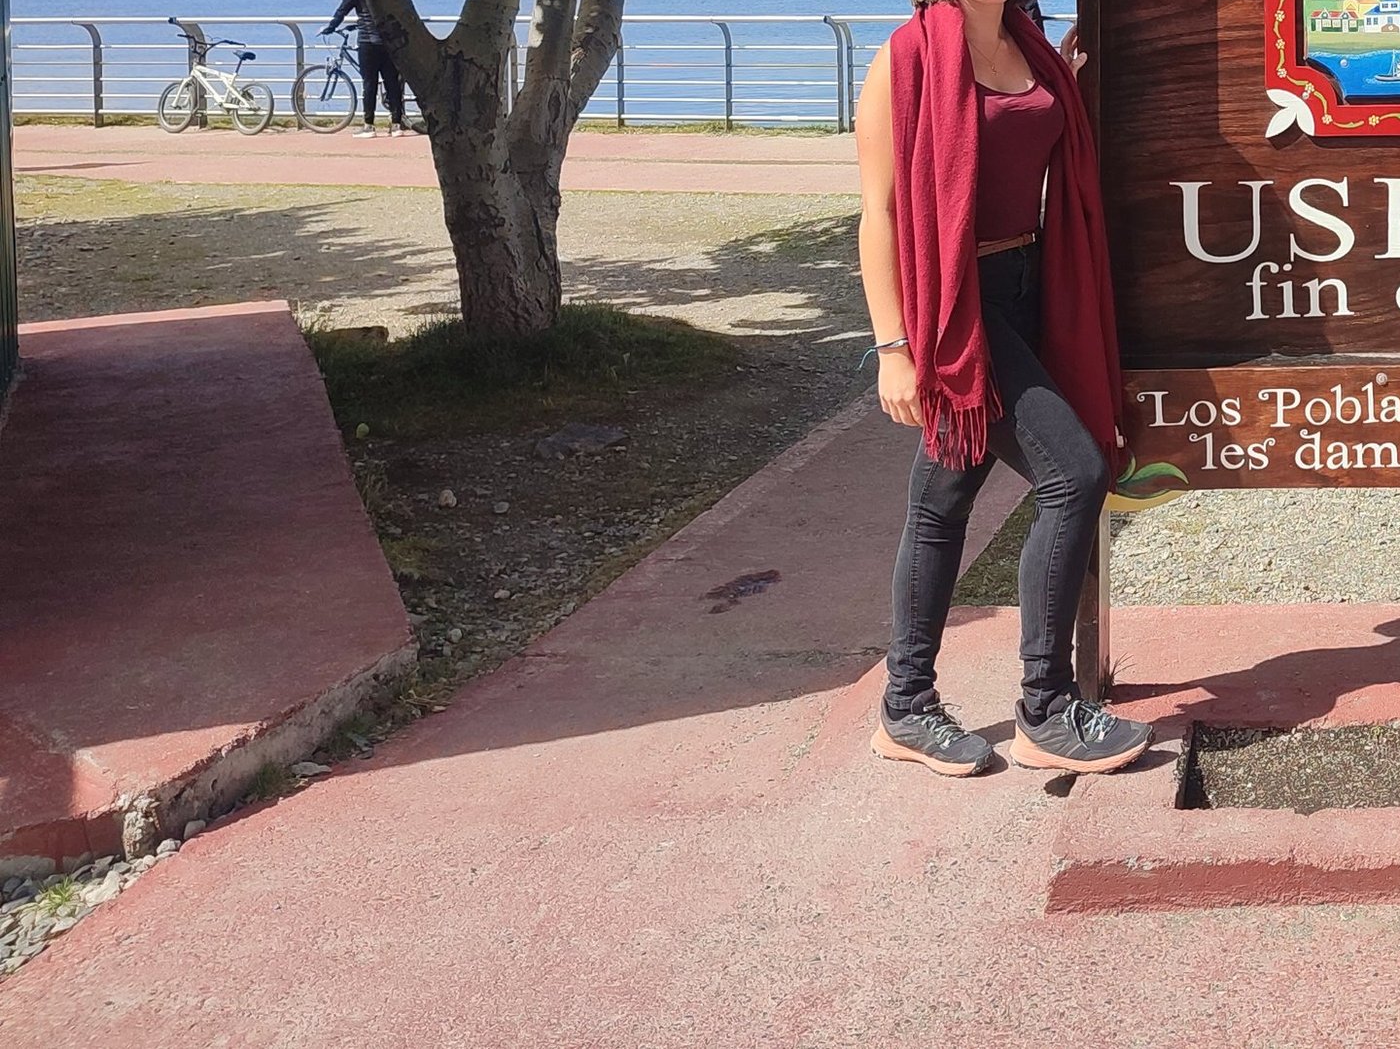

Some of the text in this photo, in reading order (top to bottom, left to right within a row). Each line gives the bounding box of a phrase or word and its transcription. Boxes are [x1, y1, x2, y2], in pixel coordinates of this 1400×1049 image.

[1245, 261, 1355, 320] fin
[1136, 390, 1242, 428] Los
[1188, 432, 1276, 471] les
